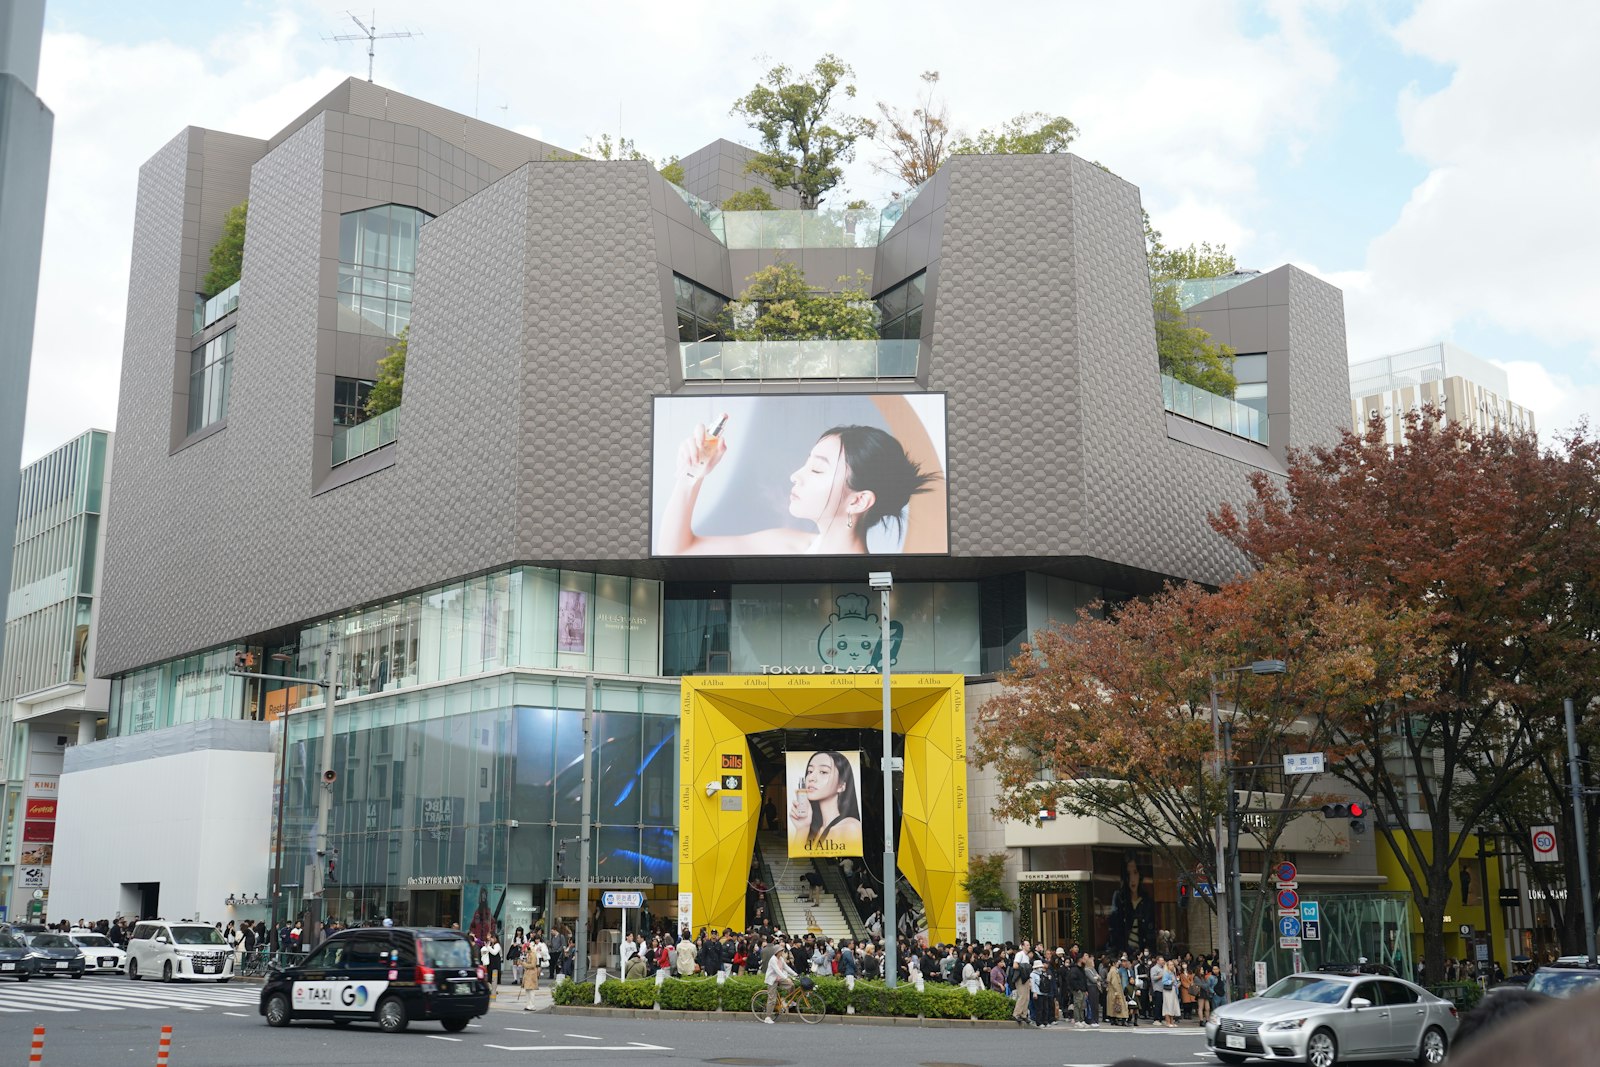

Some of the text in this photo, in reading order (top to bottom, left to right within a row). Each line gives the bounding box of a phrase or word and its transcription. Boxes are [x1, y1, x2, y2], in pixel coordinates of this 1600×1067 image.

[760, 664, 879, 674] TOKYU PLAZA
[744, 678, 767, 686] d'Alba
[787, 678, 810, 686] d'Alba
[722, 755, 742, 768] bills
[1287, 756, 1320, 766] 神宮前
[34, 781, 56, 790] KINJI
[804, 838, 846, 851] d'Alba
[1537, 837, 1551, 847] 50
[1283, 921, 1292, 935] P
[308, 985, 368, 1007] TAXI GO
